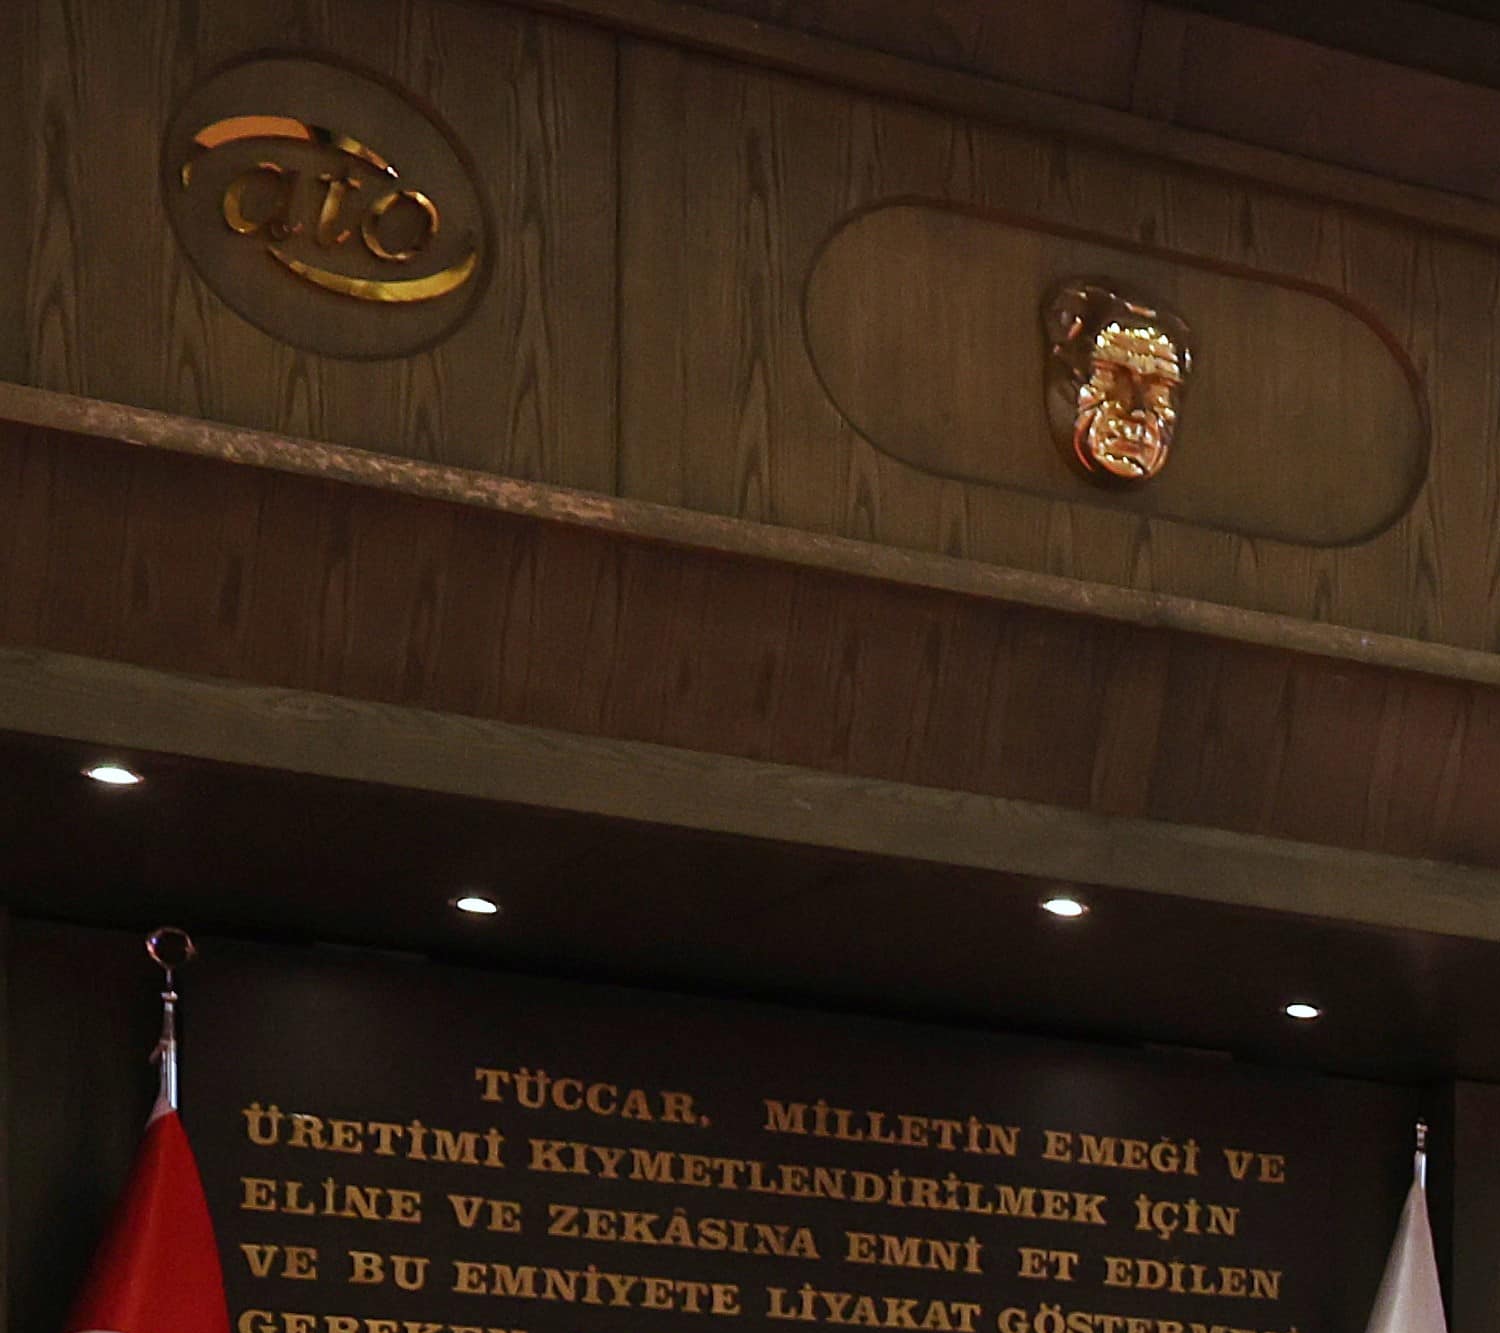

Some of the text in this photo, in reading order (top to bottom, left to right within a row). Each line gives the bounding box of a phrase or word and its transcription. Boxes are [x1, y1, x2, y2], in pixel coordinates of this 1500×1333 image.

[223, 160, 443, 262] ato
[243, 1102, 1240, 1240] ÜRETİMİ KIYMETLENDİRİLMEK İÇİN
[763, 1098, 1022, 1158] MİLLETİN
[1041, 1128, 1200, 1177] EMEĞİ
[1223, 1148, 1286, 1184] VE
[241, 1175, 422, 1224] ELİNE
[448, 1193, 522, 1233] VE
[548, 1203, 820, 1260] ZEKÂSINA
[1017, 1246, 1079, 1281] ET
[1104, 1255, 1282, 1300] EDİLEN
[241, 1243, 318, 1280] VE
[349, 1250, 430, 1286] BU
[452, 1259, 741, 1316] EMNİYETE
